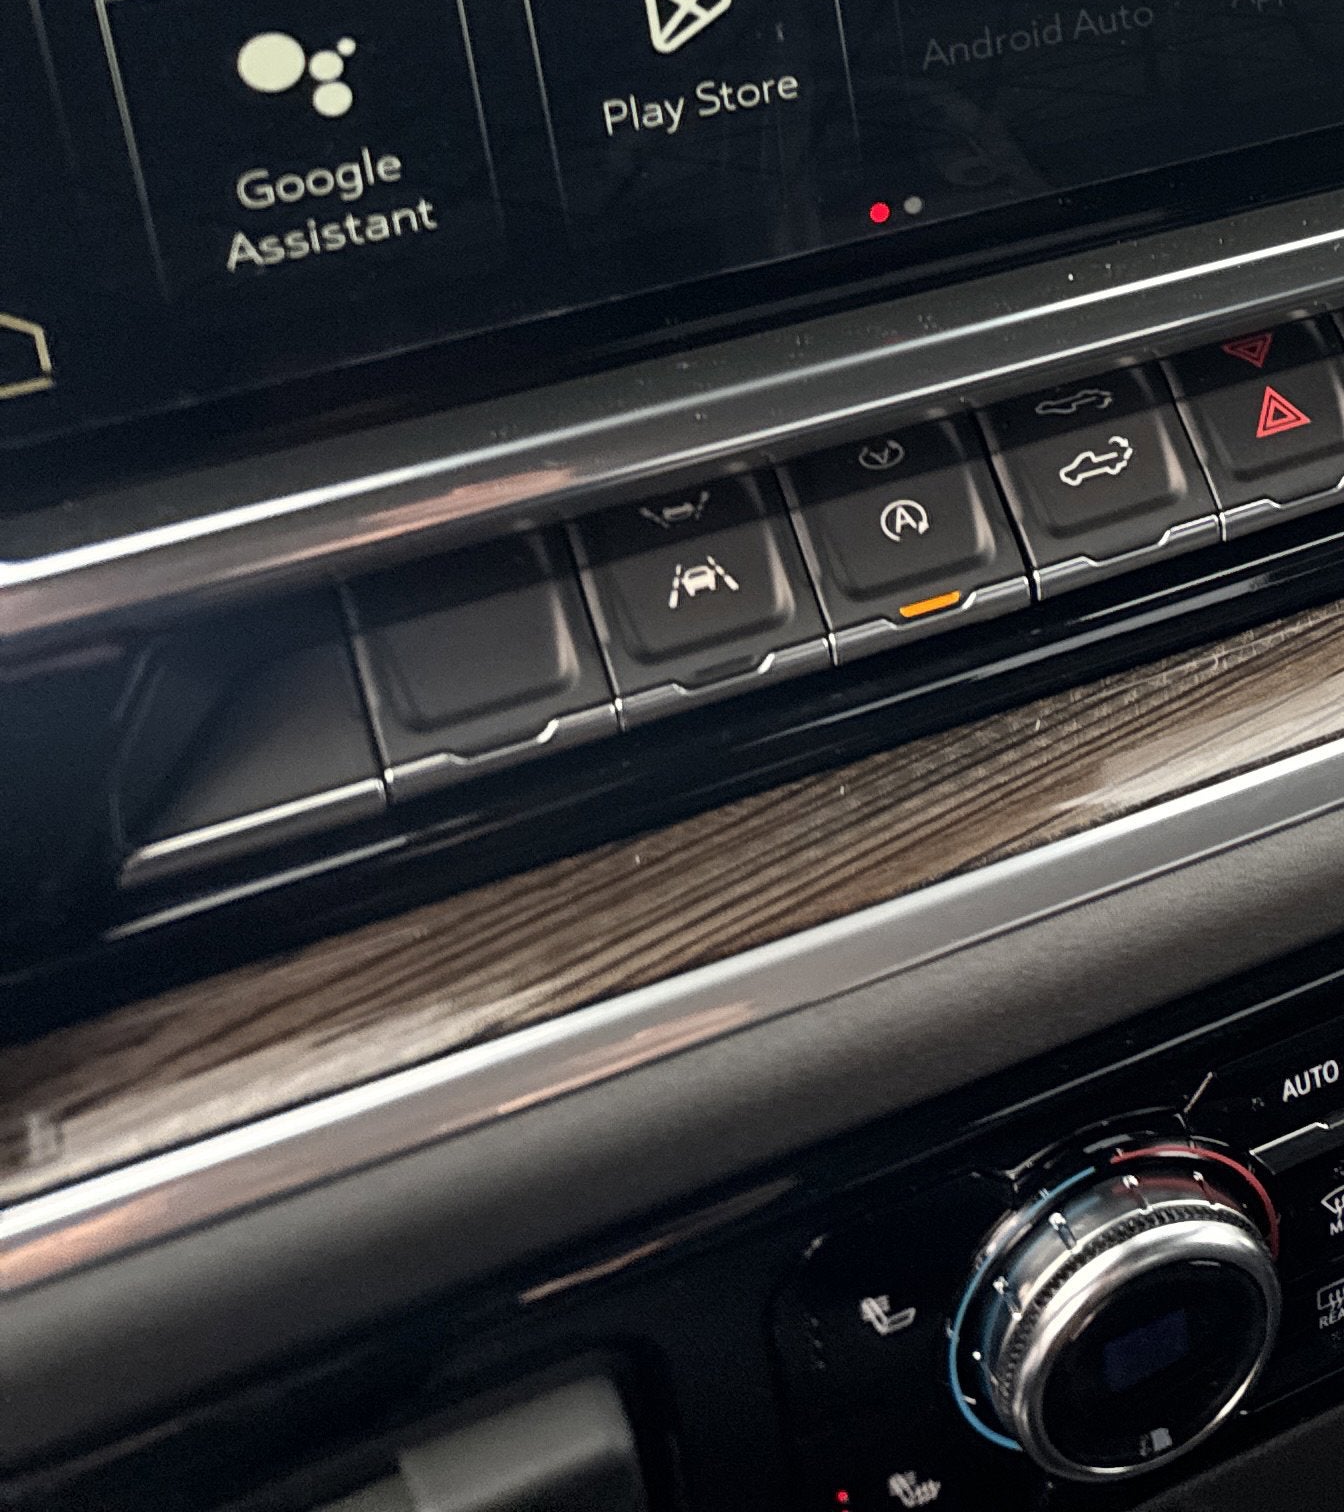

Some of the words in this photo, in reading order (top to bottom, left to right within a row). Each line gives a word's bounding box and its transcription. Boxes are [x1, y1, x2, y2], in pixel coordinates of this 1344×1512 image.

[922, 13, 1063, 71] Android
[1073, 5, 1154, 40] Auto
[603, 92, 685, 135] Play
[696, 72, 799, 117] Store
[236, 147, 403, 210] Google
[226, 196, 438, 273] Assistant
[1282, 1059, 1340, 1102] AUTO
